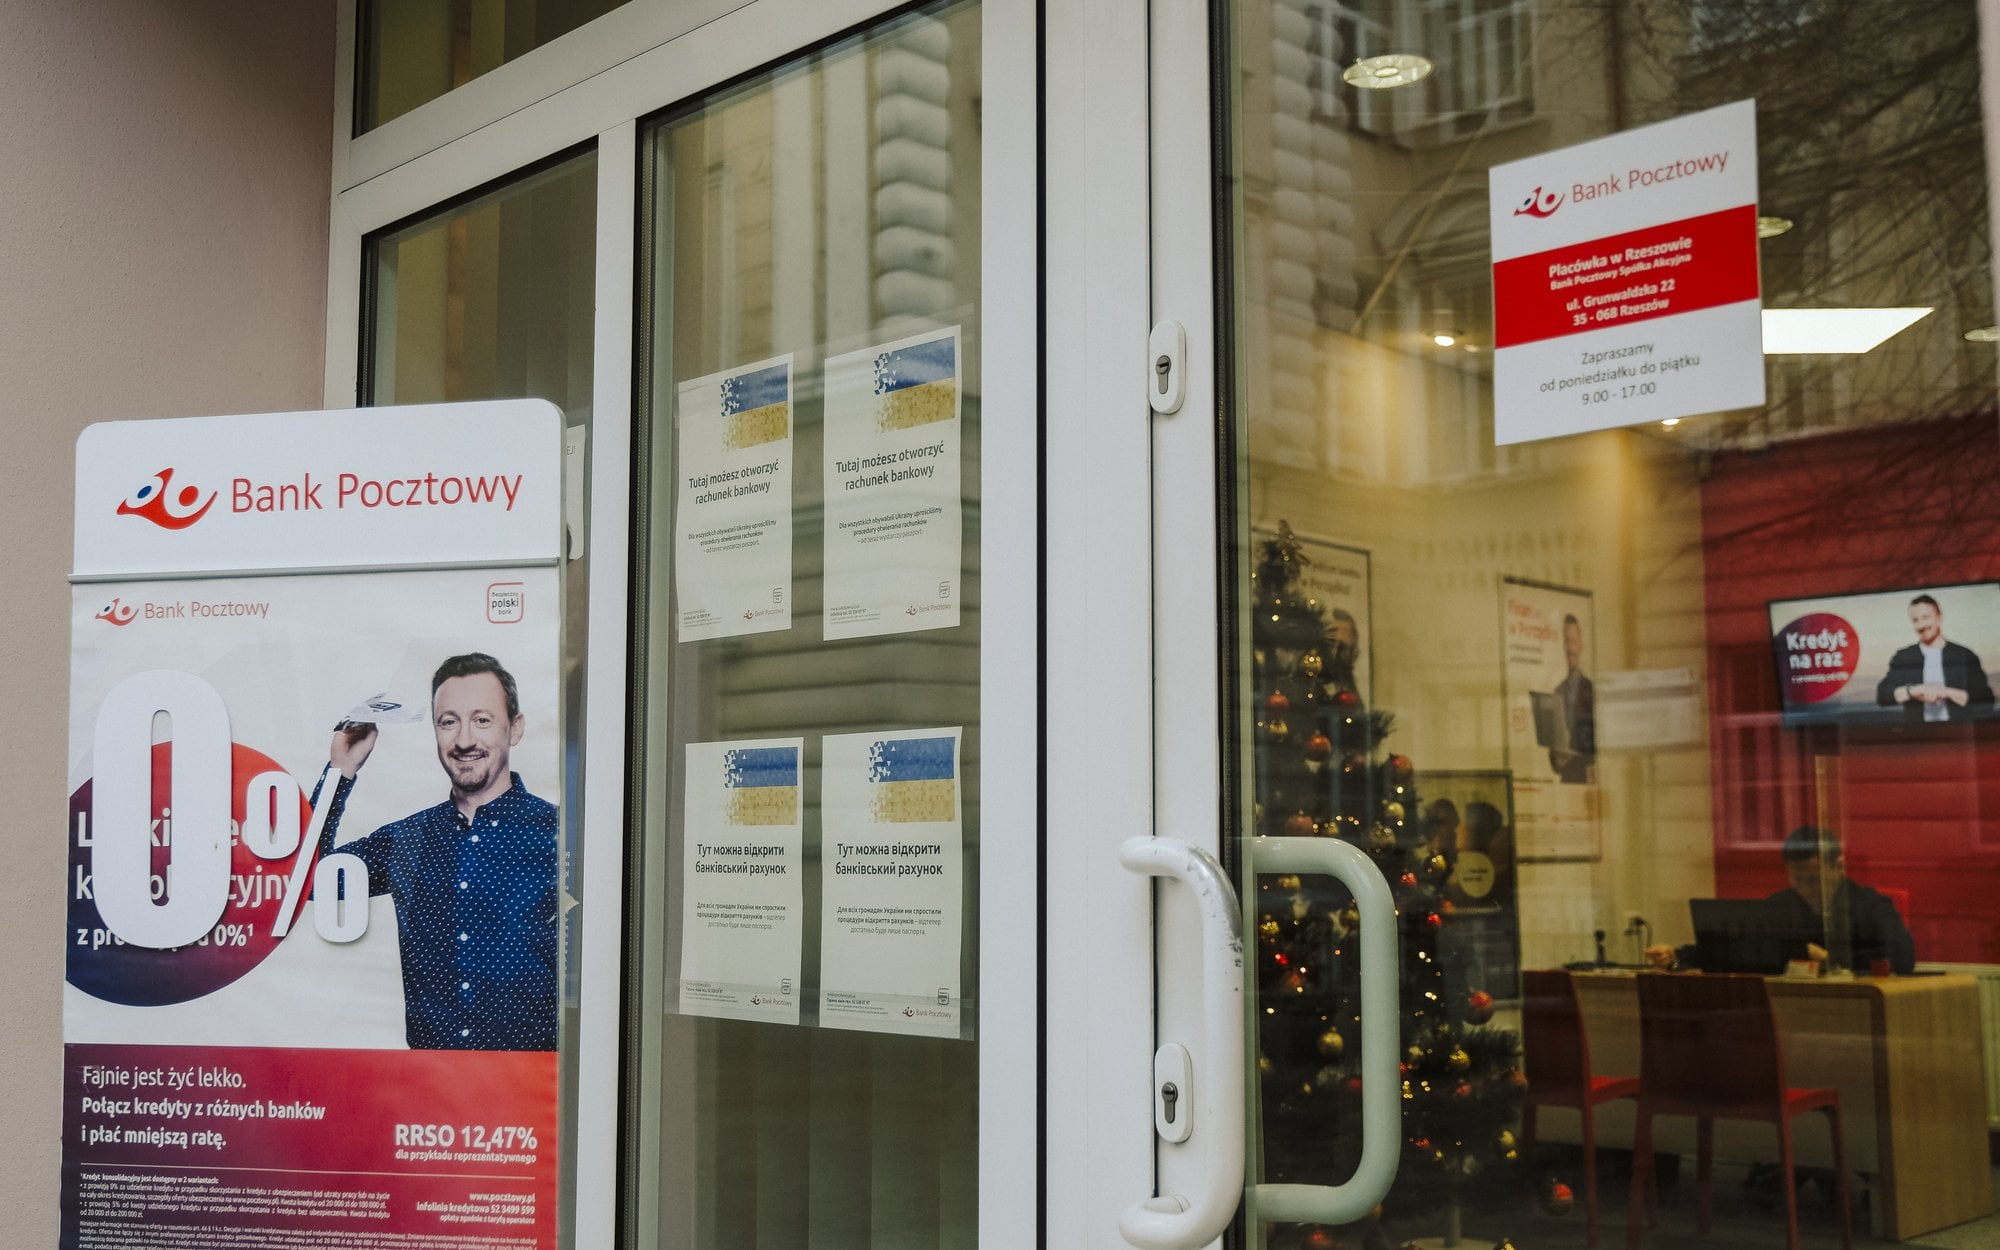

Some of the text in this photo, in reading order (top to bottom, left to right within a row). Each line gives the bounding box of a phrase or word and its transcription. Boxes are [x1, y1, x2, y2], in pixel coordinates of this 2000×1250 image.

[1573, 151, 1728, 203] Bank Pocztowy
[1549, 237, 1692, 277] Placówka w Rzeszowie
[1551, 254, 1692, 290] Bank Pocztowy Spółka Akcyjna
[1566, 279, 1675, 311] ul. Grunwaldzka 22
[1573, 314, 1587, 326] 35
[1596, 307, 1618, 321] 068
[1620, 298, 1670, 316] Rzeszów
[1582, 343, 1654, 365] Zapraszamy
[1540, 355, 1700, 392] od poniedziałku do piątku
[1582, 390, 1609, 405] 9.00
[1622, 382, 1656, 399] 17.00
[836, 440, 944, 473] Tutaj możesz otworzyć
[689, 459, 779, 488] Tutaj możesz otworzyć
[846, 466, 934, 490] rachunek bankowy
[232, 471, 523, 513] Bank Pocztowy
[696, 481, 770, 504] rachunek bankowy
[144, 600, 270, 620] Bank Pocztowy
[492, 598, 519, 609] polski
[1785, 628, 1848, 652] Kredyt
[1789, 651, 1843, 669] na raz
[92, 669, 370, 944] 0%
[697, 843, 784, 858] Тут можна відкрити
[837, 842, 940, 858] Тут можна відкрити
[696, 861, 786, 876] банківський рахунок
[836, 862, 943, 877] банківський рахунок
[83, 1066, 246, 1090] Fajnie jest żyć lekko.
[82, 1096, 326, 1120] Połącz kredyty z różnych banków
[81, 1124, 226, 1150] i płać mniejszą ratę.
[395, 1124, 538, 1151] RRSO 12,47%
[396, 1149, 536, 1164] dla przykładu reprezentatywnego
[102, 1174, 140, 1182] konsolidacyjny
[417, 1202, 535, 1214] infolinia kredytowa 52 3499 599
[469, 1193, 535, 1203] www.pocztowy.pl
